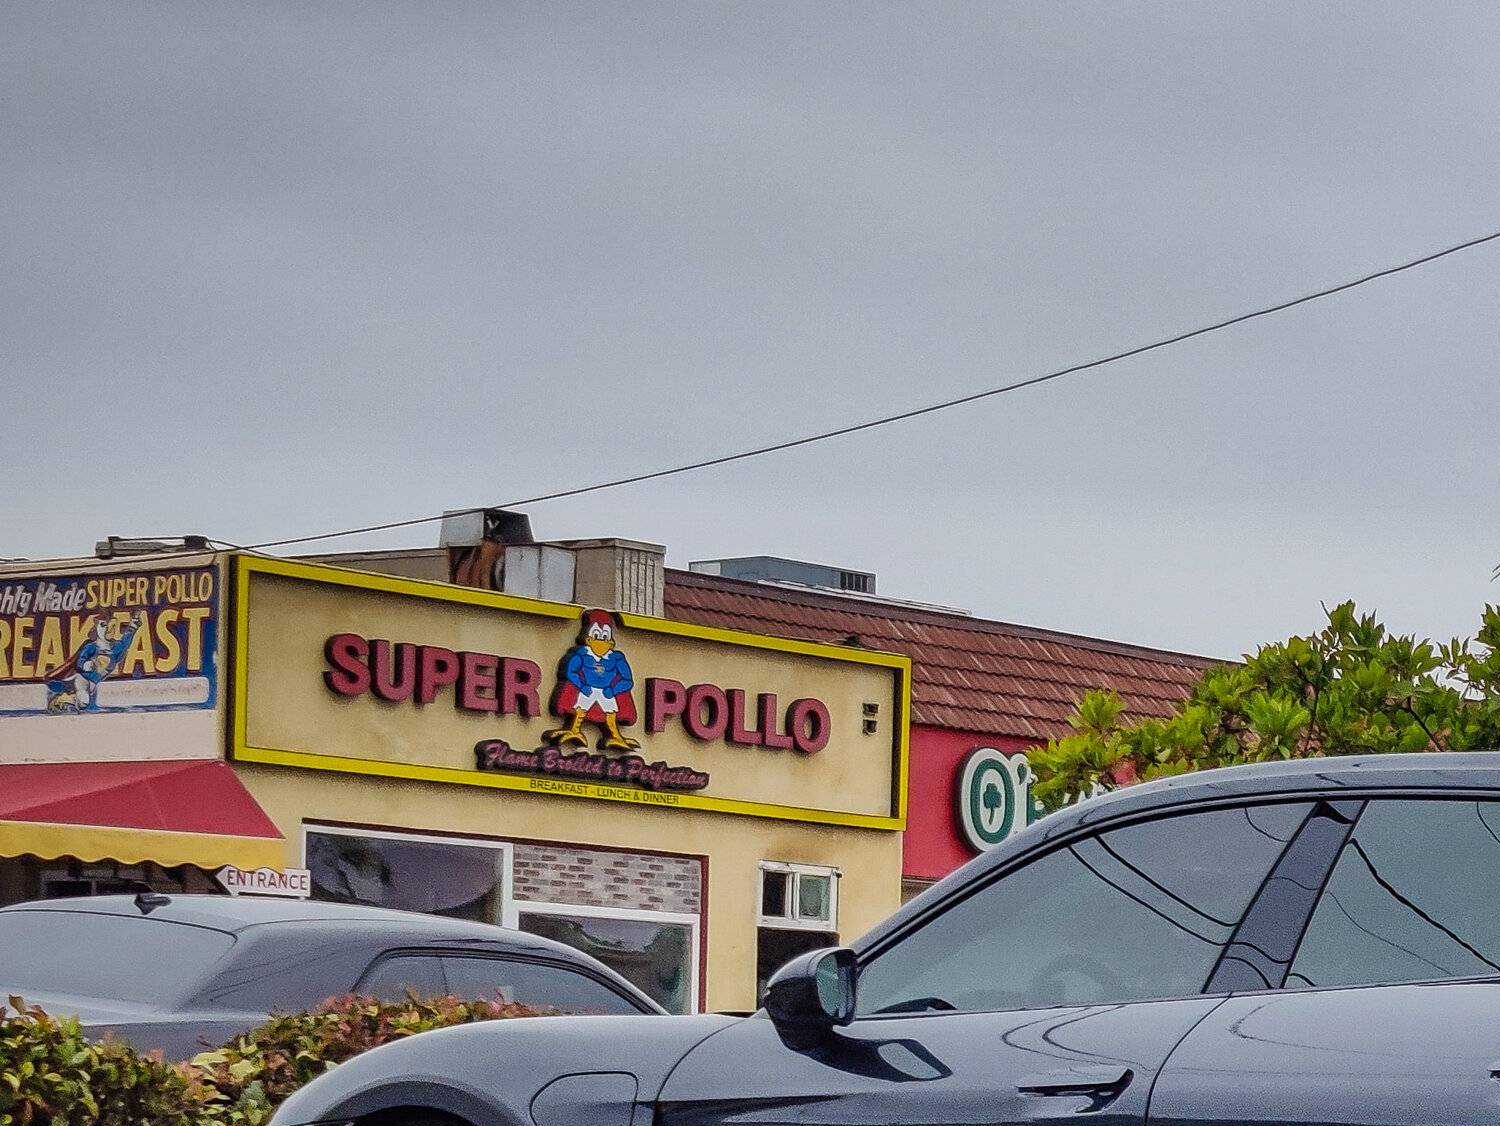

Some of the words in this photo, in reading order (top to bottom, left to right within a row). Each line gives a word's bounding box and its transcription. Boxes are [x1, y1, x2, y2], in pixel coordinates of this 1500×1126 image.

[33, 581, 87, 612] Made
[86, 577, 149, 609] SUPER
[154, 572, 214, 604] POLLO
[323, 632, 542, 717] SUPER
[645, 677, 832, 755] POLLO
[530, 779, 589, 796] BREAKFAST
[597, 788, 631, 800] LUNCH
[643, 792, 680, 804] DINNER
[227, 869, 308, 891] ENTRANCE
